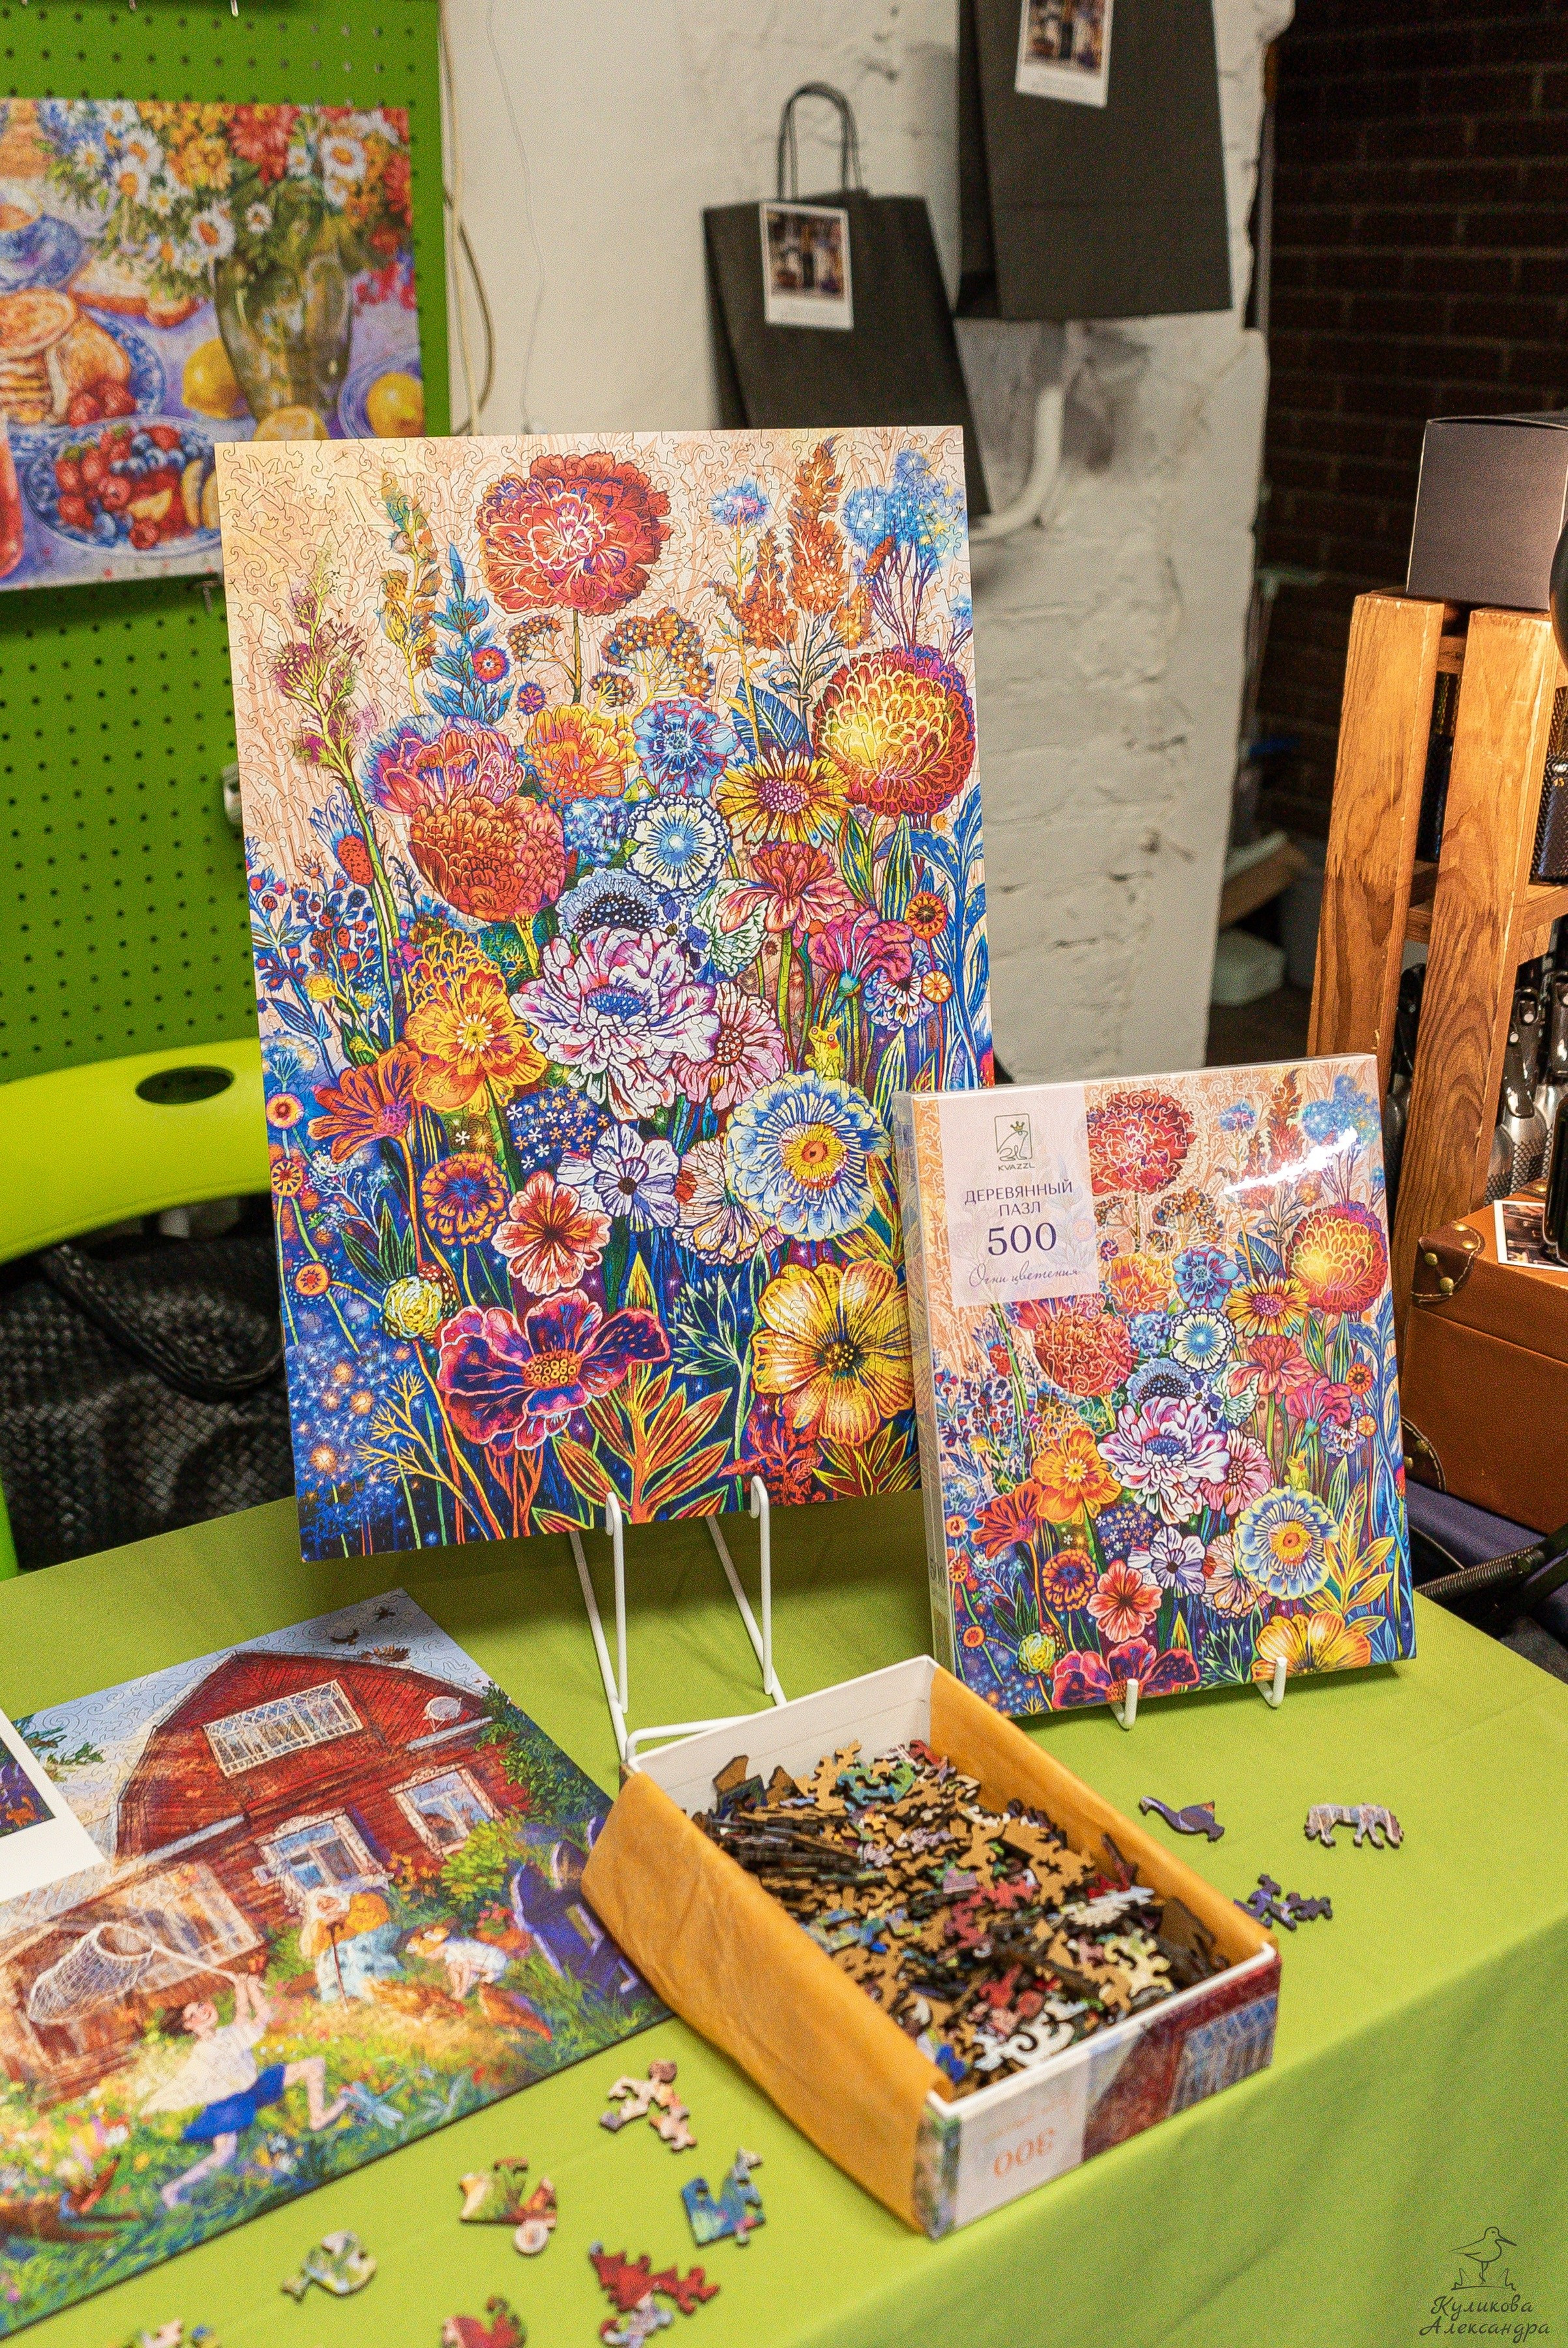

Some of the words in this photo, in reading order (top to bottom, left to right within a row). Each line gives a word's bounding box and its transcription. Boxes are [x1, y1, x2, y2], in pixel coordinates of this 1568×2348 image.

[998, 1162, 1035, 1172] KVAZZL
[964, 1179, 1072, 1205] ДЕРЕВЯННЫЙ
[999, 1202, 1041, 1216] ПАЗЛ
[988, 1222, 1057, 1255] 500
[969, 1263, 1008, 1287] Огни
[1011, 1260, 1078, 1284] цветения
[993, 2127, 1055, 2178] 300
